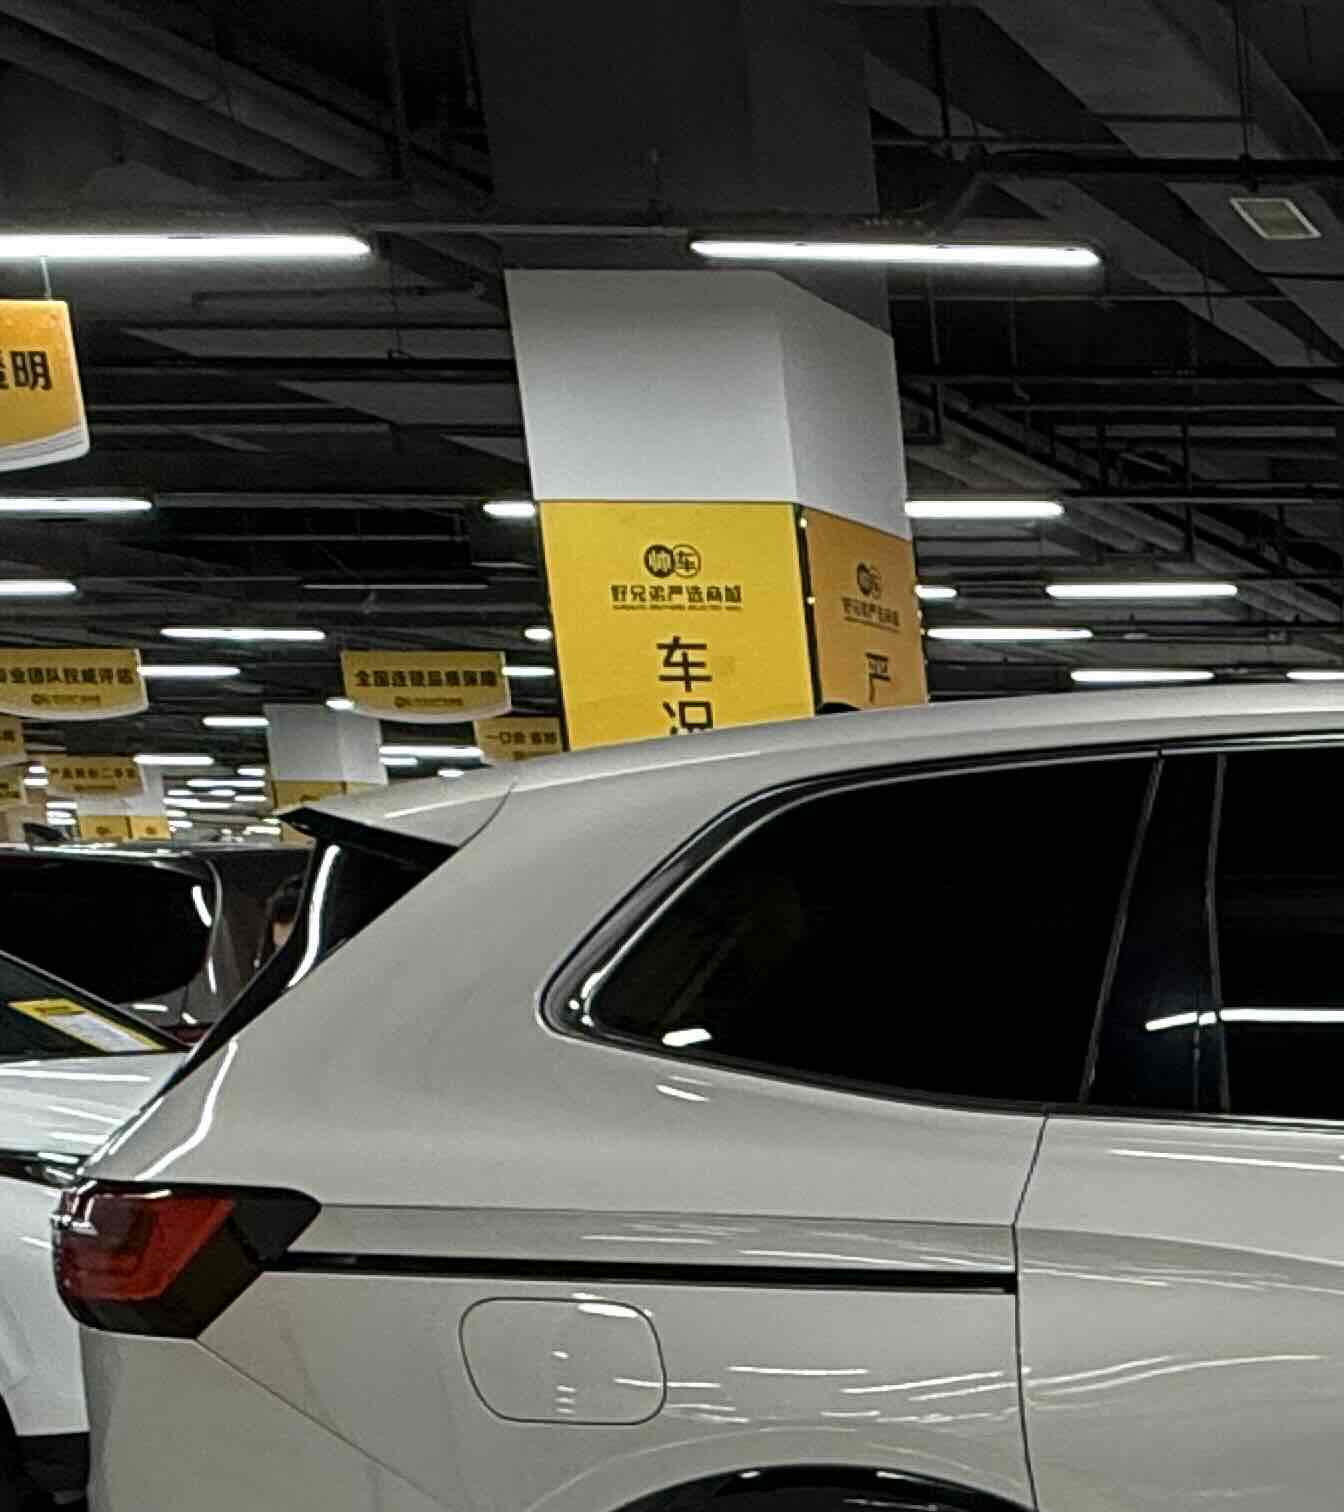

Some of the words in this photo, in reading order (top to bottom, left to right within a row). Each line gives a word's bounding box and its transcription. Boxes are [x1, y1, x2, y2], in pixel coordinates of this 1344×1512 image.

[610, 585, 742, 603] 好兄弟严选商城
